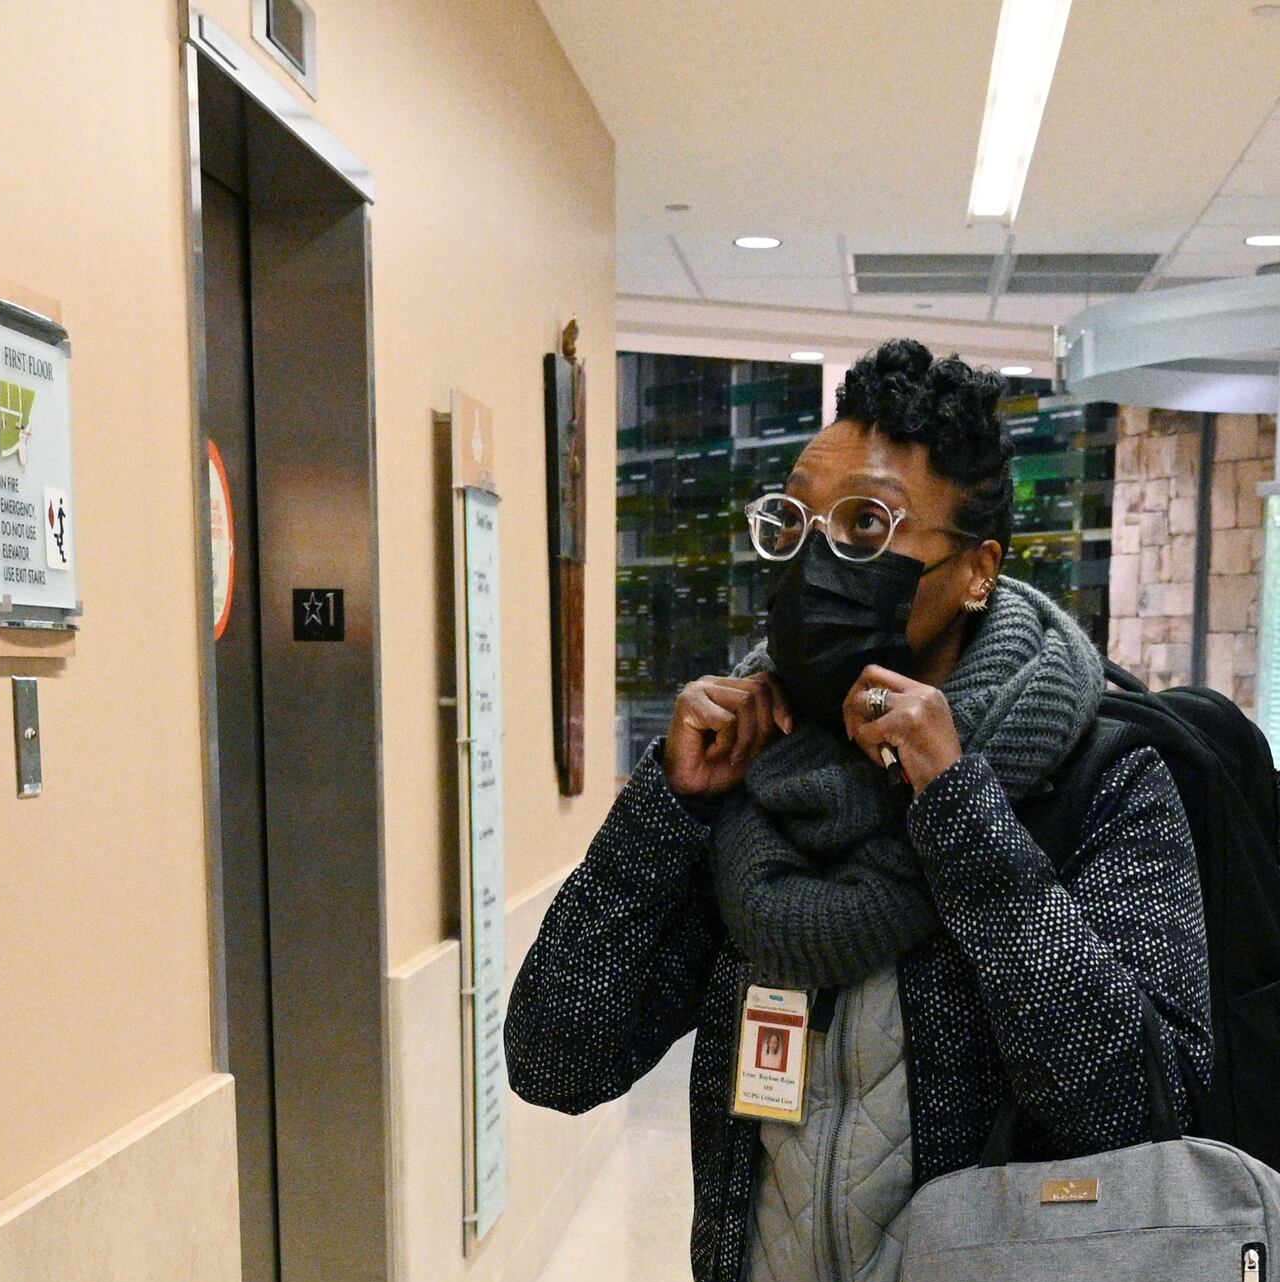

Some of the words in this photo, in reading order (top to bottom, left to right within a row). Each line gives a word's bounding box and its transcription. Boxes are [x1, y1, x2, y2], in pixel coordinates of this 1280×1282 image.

[4, 346, 26, 372] FIRST
[28, 355, 54, 382] FLOOR
[8, 477, 19, 493] FIRE
[2, 521, 11, 536] DO
[12, 522, 24, 538] NOT
[25, 525, 37, 540] USE
[4, 566, 15, 582] USE
[15, 567, 26, 583] EXIT
[326, 592, 334, 626] 1
